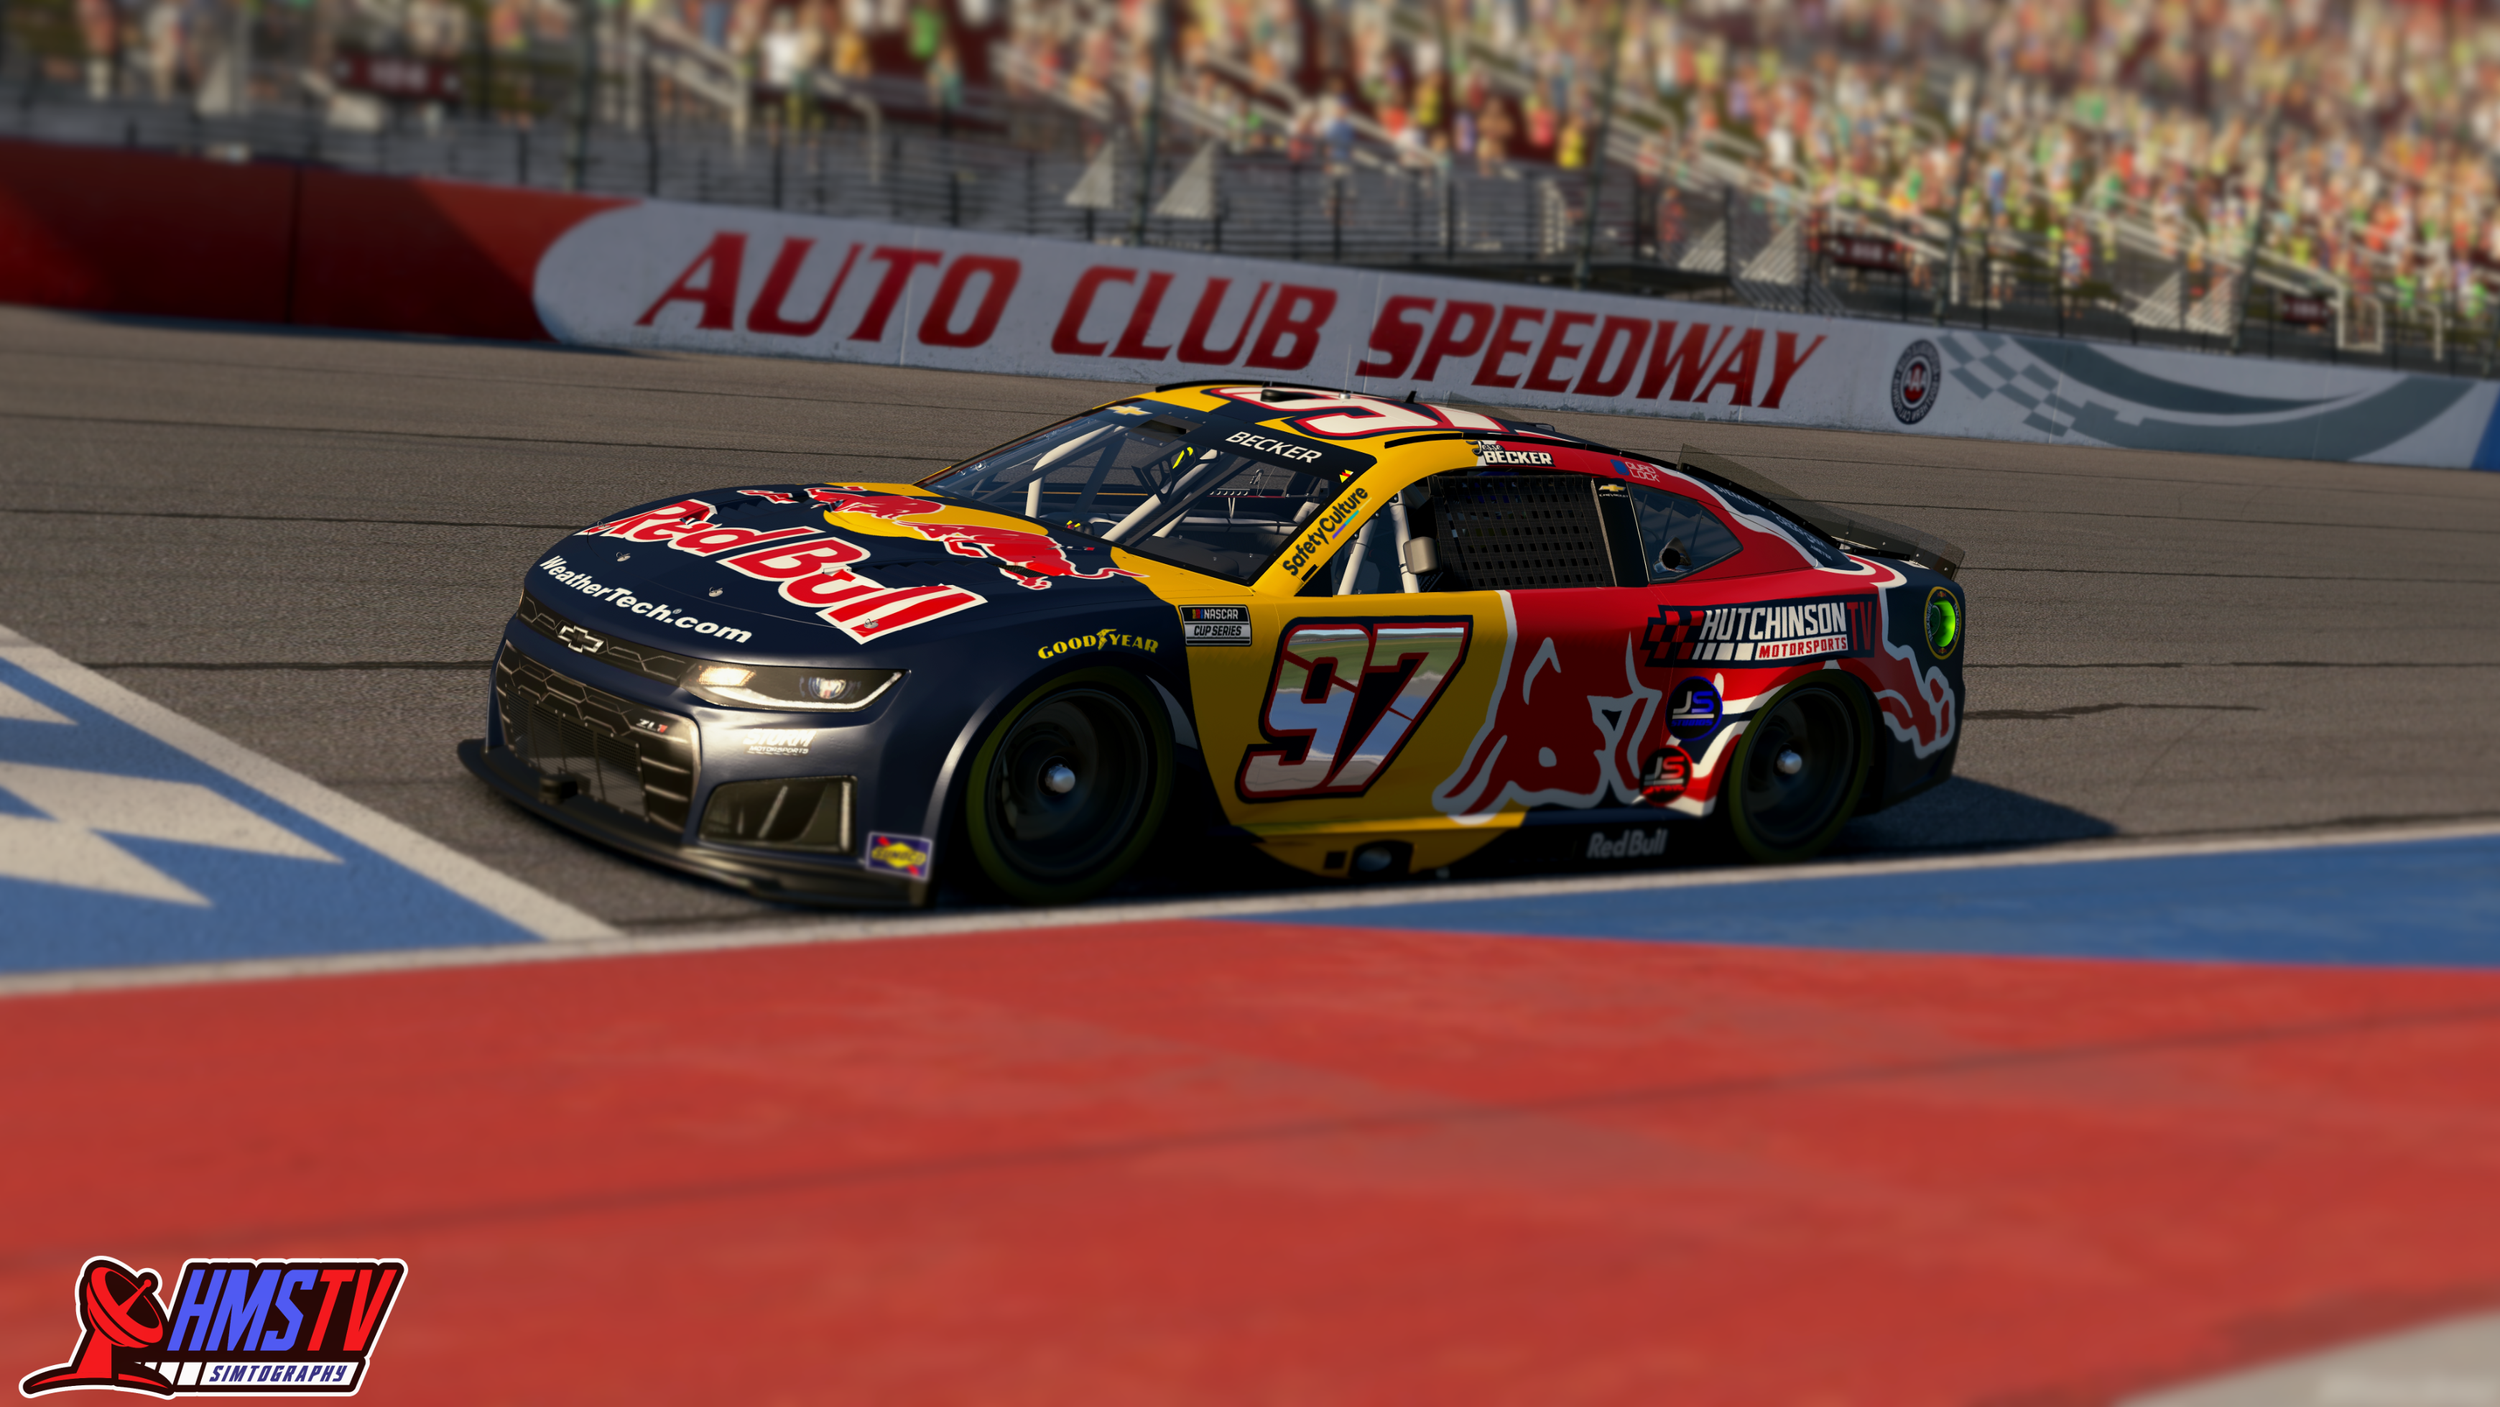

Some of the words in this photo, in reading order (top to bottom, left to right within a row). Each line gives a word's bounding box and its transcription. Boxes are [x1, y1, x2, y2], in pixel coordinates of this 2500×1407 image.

[634, 230, 1022, 348] AUTO
[1050, 264, 1338, 371] CLUB
[1355, 294, 1828, 410] SPEEDWAY
[1225, 431, 1322, 464] BECKER
[1483, 450, 1553, 465] BECKER
[1629, 469, 1661, 482] LOCK
[1282, 487, 1368, 576] SafetyCulture
[575, 499, 826, 556] Red
[716, 537, 989, 645] Bull
[1203, 609, 1239, 619] NASCAR
[1699, 602, 1847, 641] HUTCHINSON
[1846, 601, 1873, 651] TV
[1194, 625, 1212, 636] CUP
[1211, 625, 1242, 636] SERIES
[1758, 636, 1848, 659] MOTORSPORTS
[1238, 619, 1471, 803] 97
[1672, 690, 1715, 714] JS
[636, 718, 668, 733] ZL1
[743, 728, 817, 747] STORM
[748, 746, 809, 755] MOTORSPORTS
[1643, 755, 1686, 780] JS
[1586, 829, 1630, 859] Red
[1627, 827, 1669, 857] Bull
